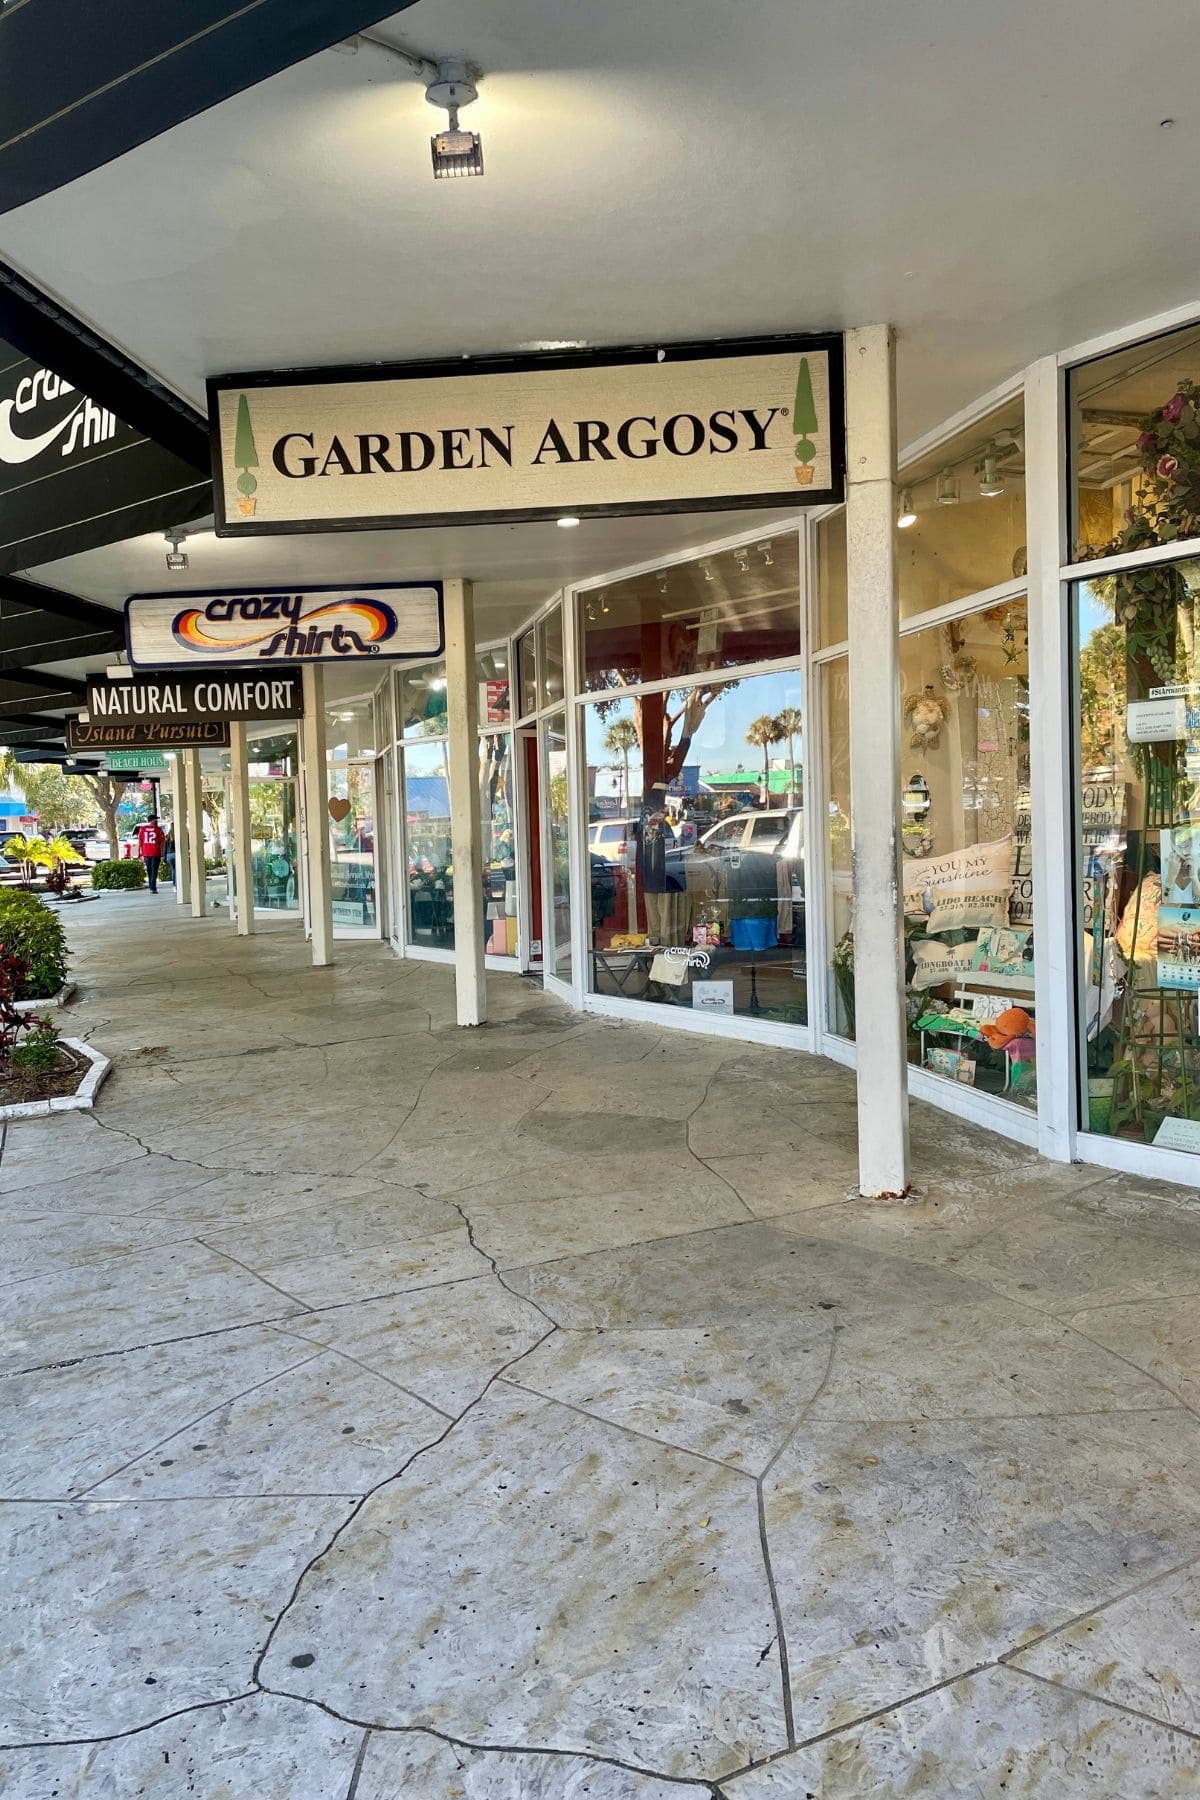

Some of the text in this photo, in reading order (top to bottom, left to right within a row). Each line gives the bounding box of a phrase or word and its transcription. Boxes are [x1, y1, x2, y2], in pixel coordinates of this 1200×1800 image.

[272, 426, 515, 479] GARDEN
[205, 595, 303, 623] crazy
[92, 680, 295, 716] NATURAL COMFORT
[75, 724, 136, 743] Island
[112, 756, 168, 768] BEACH HOUSE
[143, 831, 157, 844] 12
[931, 855, 988, 875] YOU MY
[936, 893, 1002, 907] LIDO BEACH
[921, 960, 966, 969] LONGBOAT
